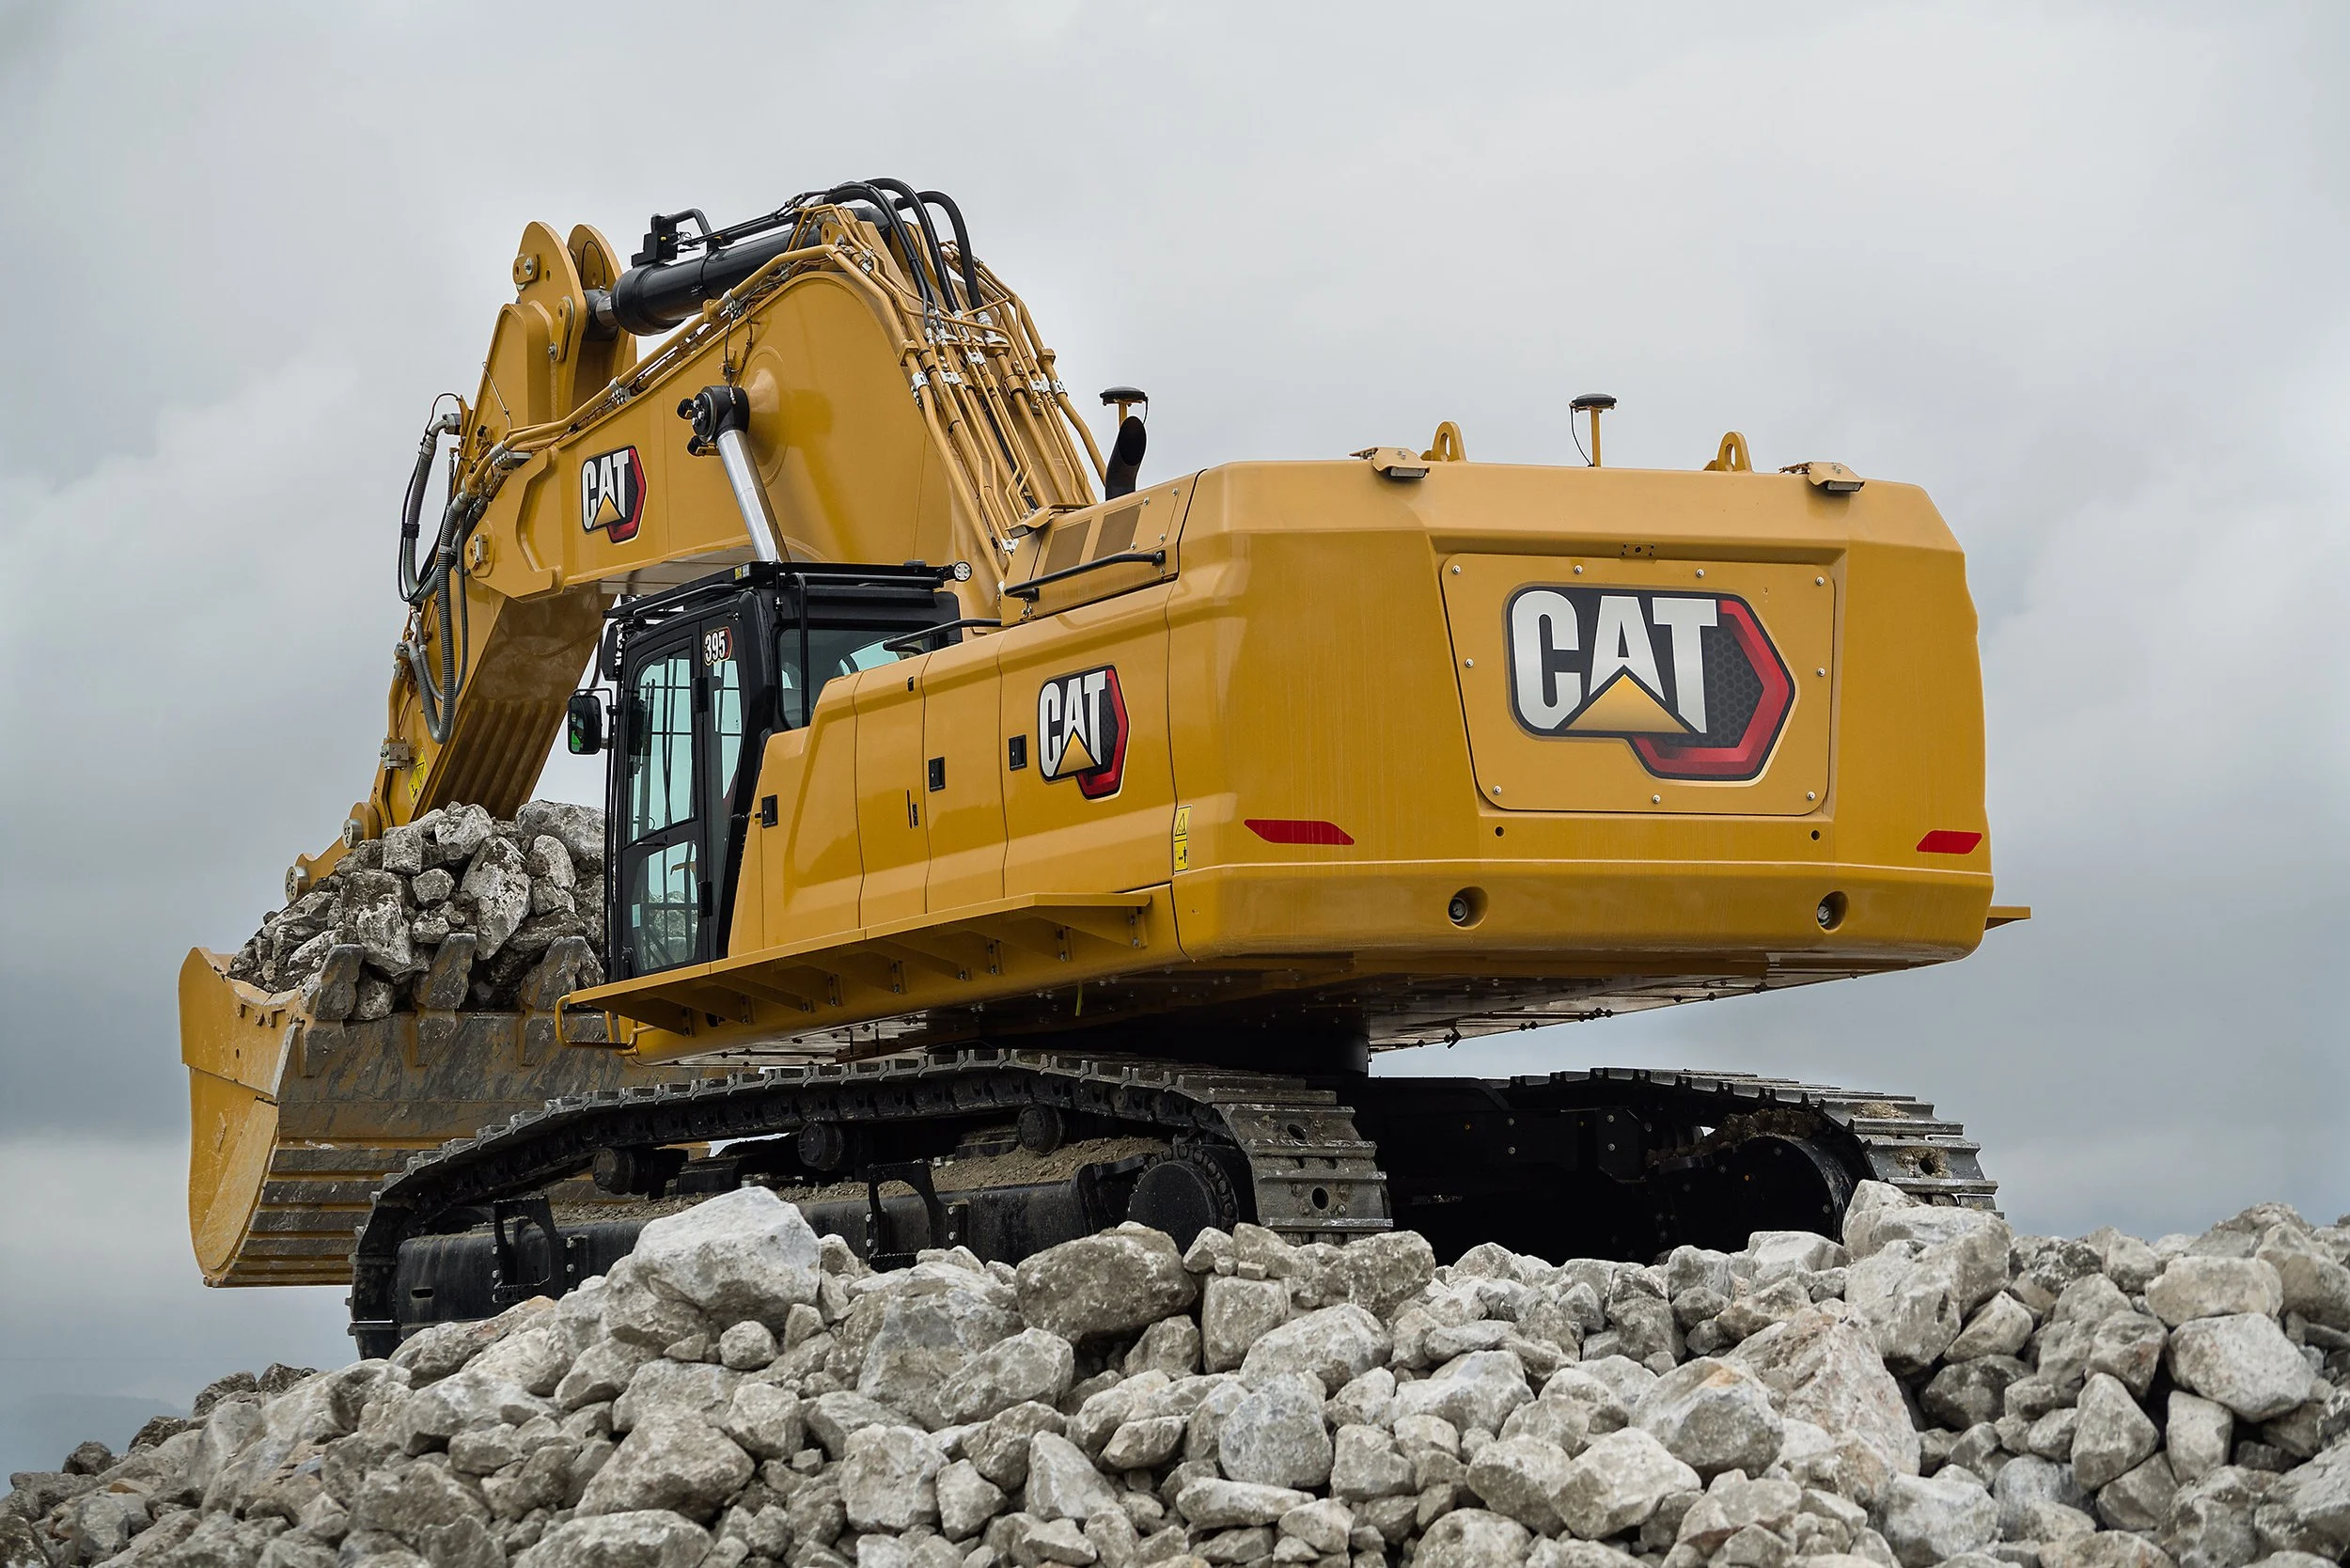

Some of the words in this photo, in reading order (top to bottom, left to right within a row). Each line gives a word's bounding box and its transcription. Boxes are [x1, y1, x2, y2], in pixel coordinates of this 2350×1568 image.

[582, 449, 629, 529] CAT
[705, 630, 726, 662] 395
[1512, 590, 1718, 733] CAT
[1039, 670, 1106, 777] CAT
